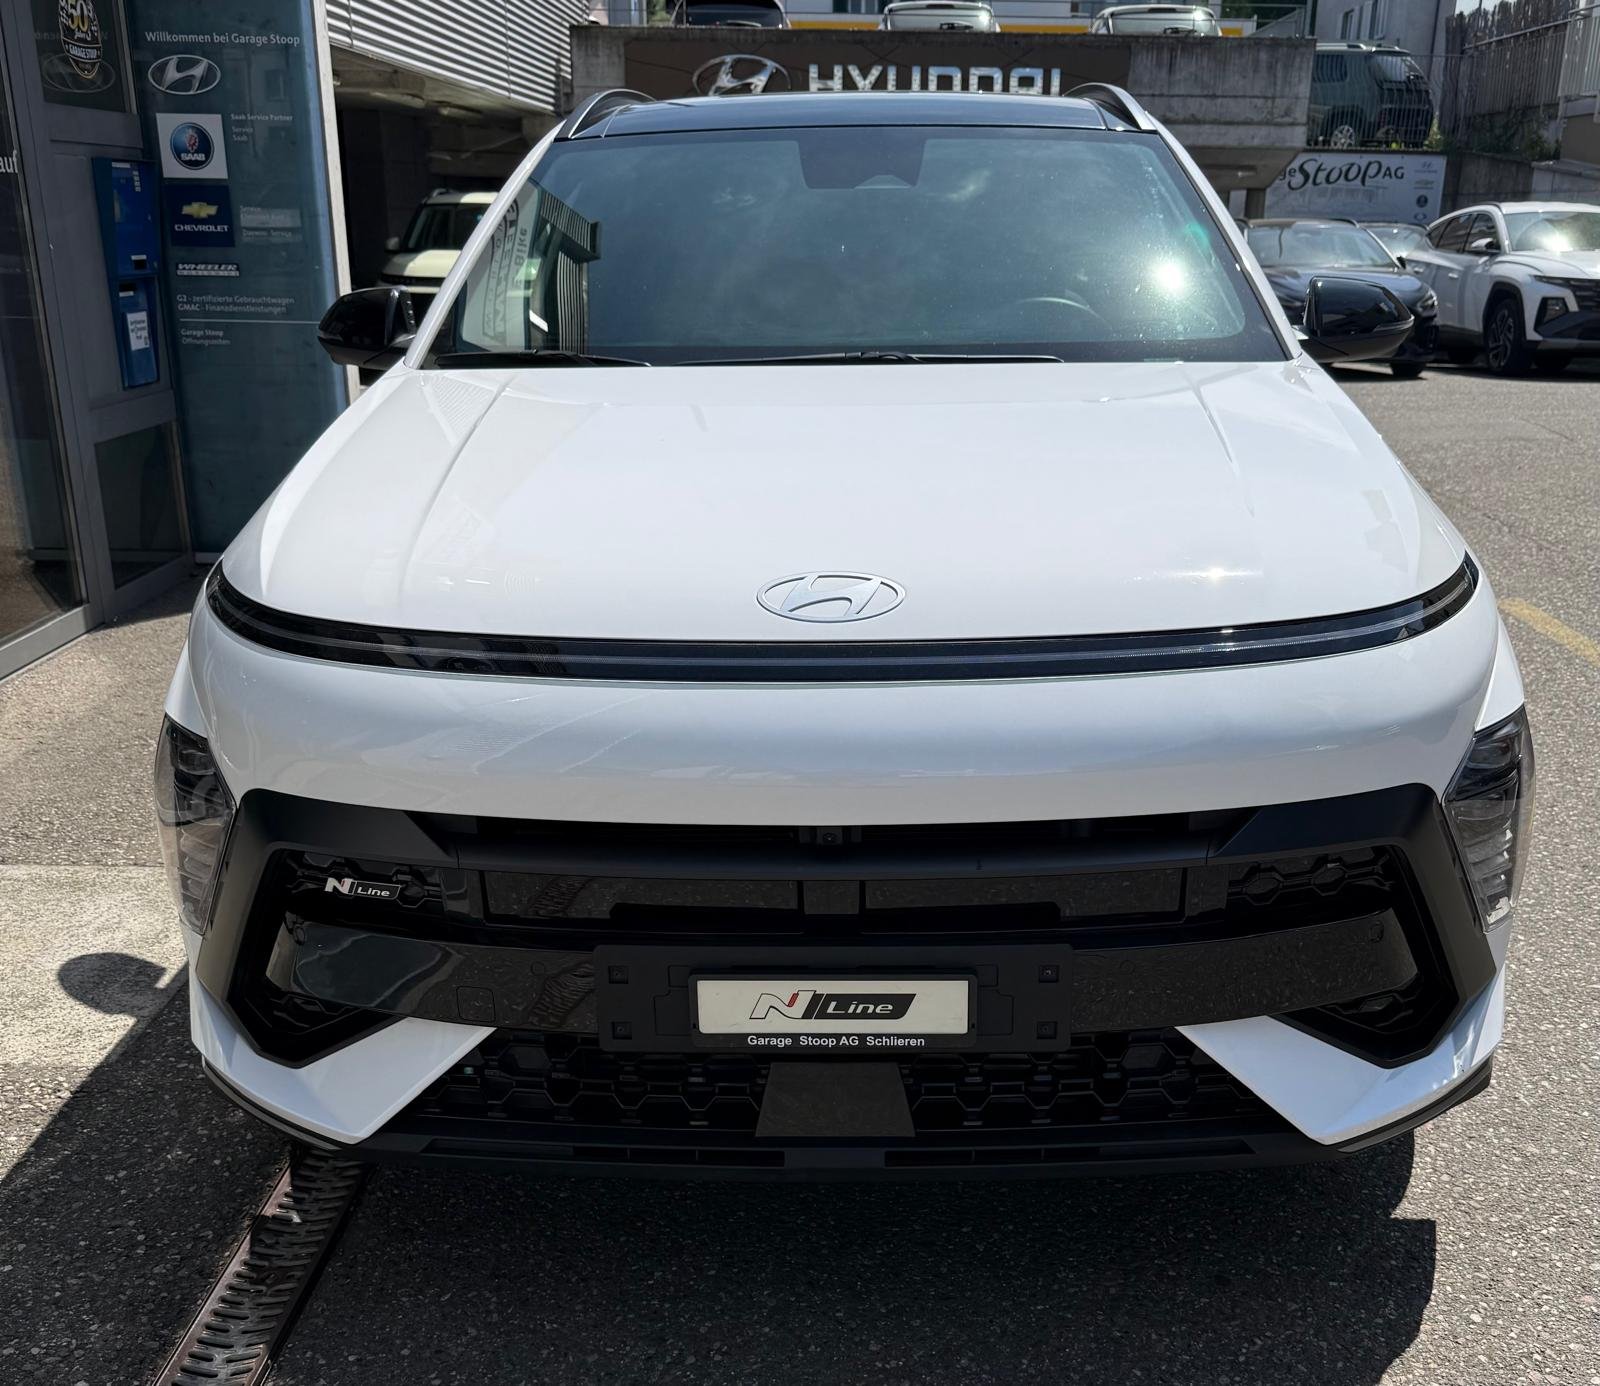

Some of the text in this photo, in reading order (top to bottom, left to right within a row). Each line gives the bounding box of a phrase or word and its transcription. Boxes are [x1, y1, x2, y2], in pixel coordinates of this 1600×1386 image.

[145, 31, 300, 47] Willkommen bei Garage Stoop
[180, 153, 206, 161] SAAB
[1287, 158, 1382, 191] Stoop
[1382, 166, 1405, 180] AG
[174, 224, 229, 232] CHEVROLET
[234, 295, 295, 305] Gebrauchtwagen
[177, 303, 200, 311] GMAC
[324, 877, 391, 897] N Line
[749, 989, 894, 1019] N Line
[747, 1036, 925, 1048] Garage Stoop AG Schlieren
